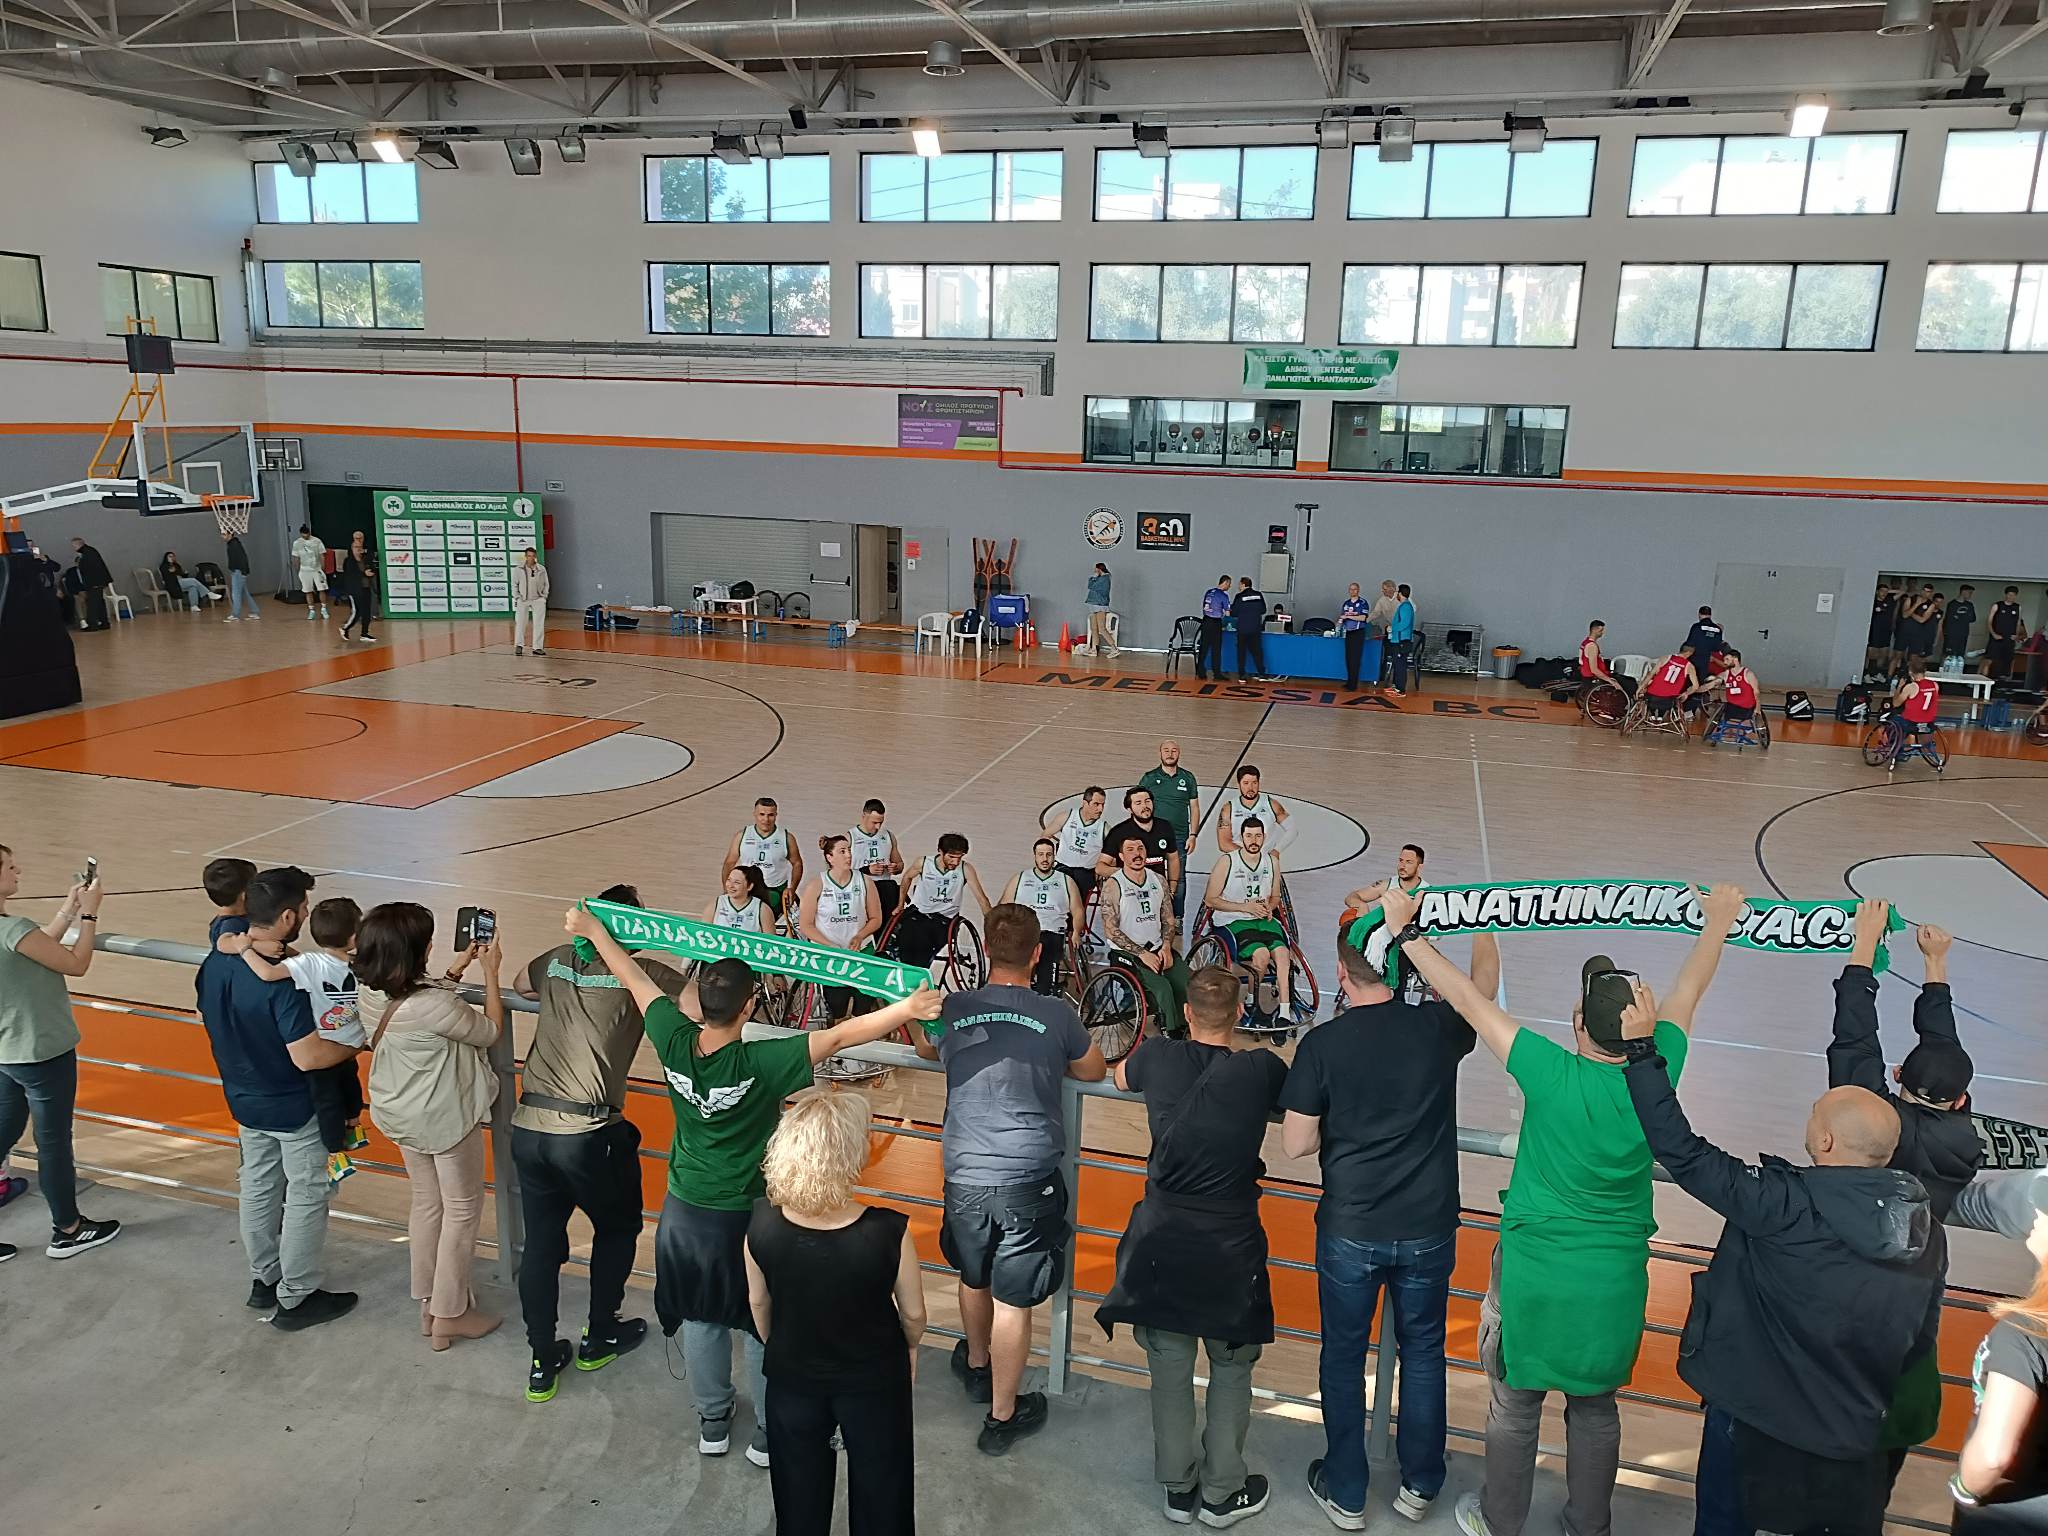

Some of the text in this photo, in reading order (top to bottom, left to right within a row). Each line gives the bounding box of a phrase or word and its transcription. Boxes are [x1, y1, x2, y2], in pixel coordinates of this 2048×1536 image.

[1767, 570, 1777, 578] 14
[1663, 665, 1682, 684] 11
[1036, 672, 1543, 720] MELISSIA BC
[1075, 837, 1087, 848] 22
[869, 847, 878, 858] 10
[936, 887, 947, 898] 14
[1246, 885, 1260, 898] 34
[1037, 893, 1047, 905] 19
[838, 903, 850, 915] 12
[1141, 901, 1151, 914] 13
[953, 1012, 1047, 1034] PANATHINAIKOS
